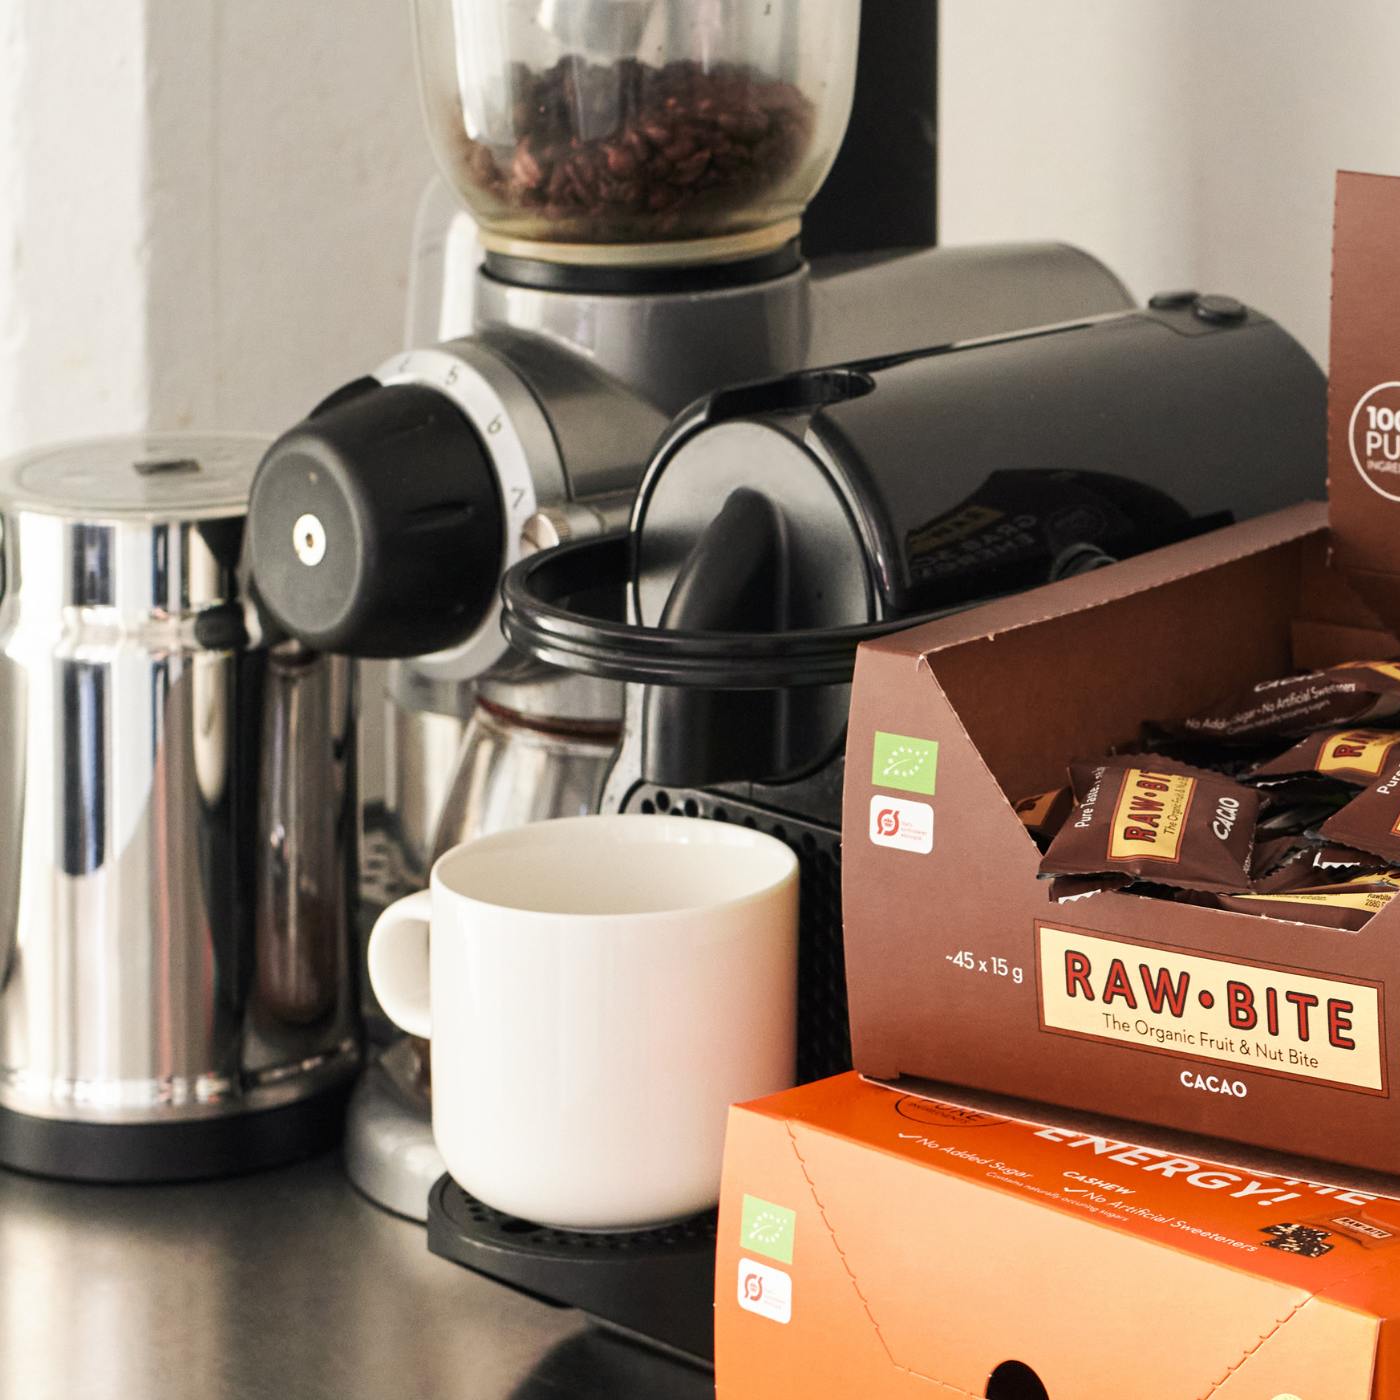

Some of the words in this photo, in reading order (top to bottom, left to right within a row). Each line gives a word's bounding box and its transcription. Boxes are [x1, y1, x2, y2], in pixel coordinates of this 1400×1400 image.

[486, 413, 502, 434] 6
[510, 486, 525, 509] 7
[1074, 808, 1094, 828] Pure
[1212, 797, 1240, 840] CACAO
[978, 960, 988, 973] x
[991, 956, 1009, 977] 15
[1012, 966, 1023, 984] g
[1102, 1012, 1131, 1032] The
[1134, 1020, 1196, 1046] Organic
[1199, 1032, 1236, 1053] Fruit
[1239, 1040, 1251, 1057] &
[1255, 1041, 1283, 1062] Nut
[1288, 1049, 1319, 1070] Bite
[1180, 1070, 1247, 1098] CACAO
[917, 1137, 939, 1149] No
[942, 1146, 991, 1166] Added
[988, 1161, 1034, 1179] Sugar
[1033, 1128, 1302, 1206] ENERGY!
[1062, 1171, 1136, 1195] CASHEW
[1083, 1191, 1106, 1203] No
[1110, 1200, 1168, 1224] Artificial
[1170, 1219, 1258, 1253] Sweeteners
